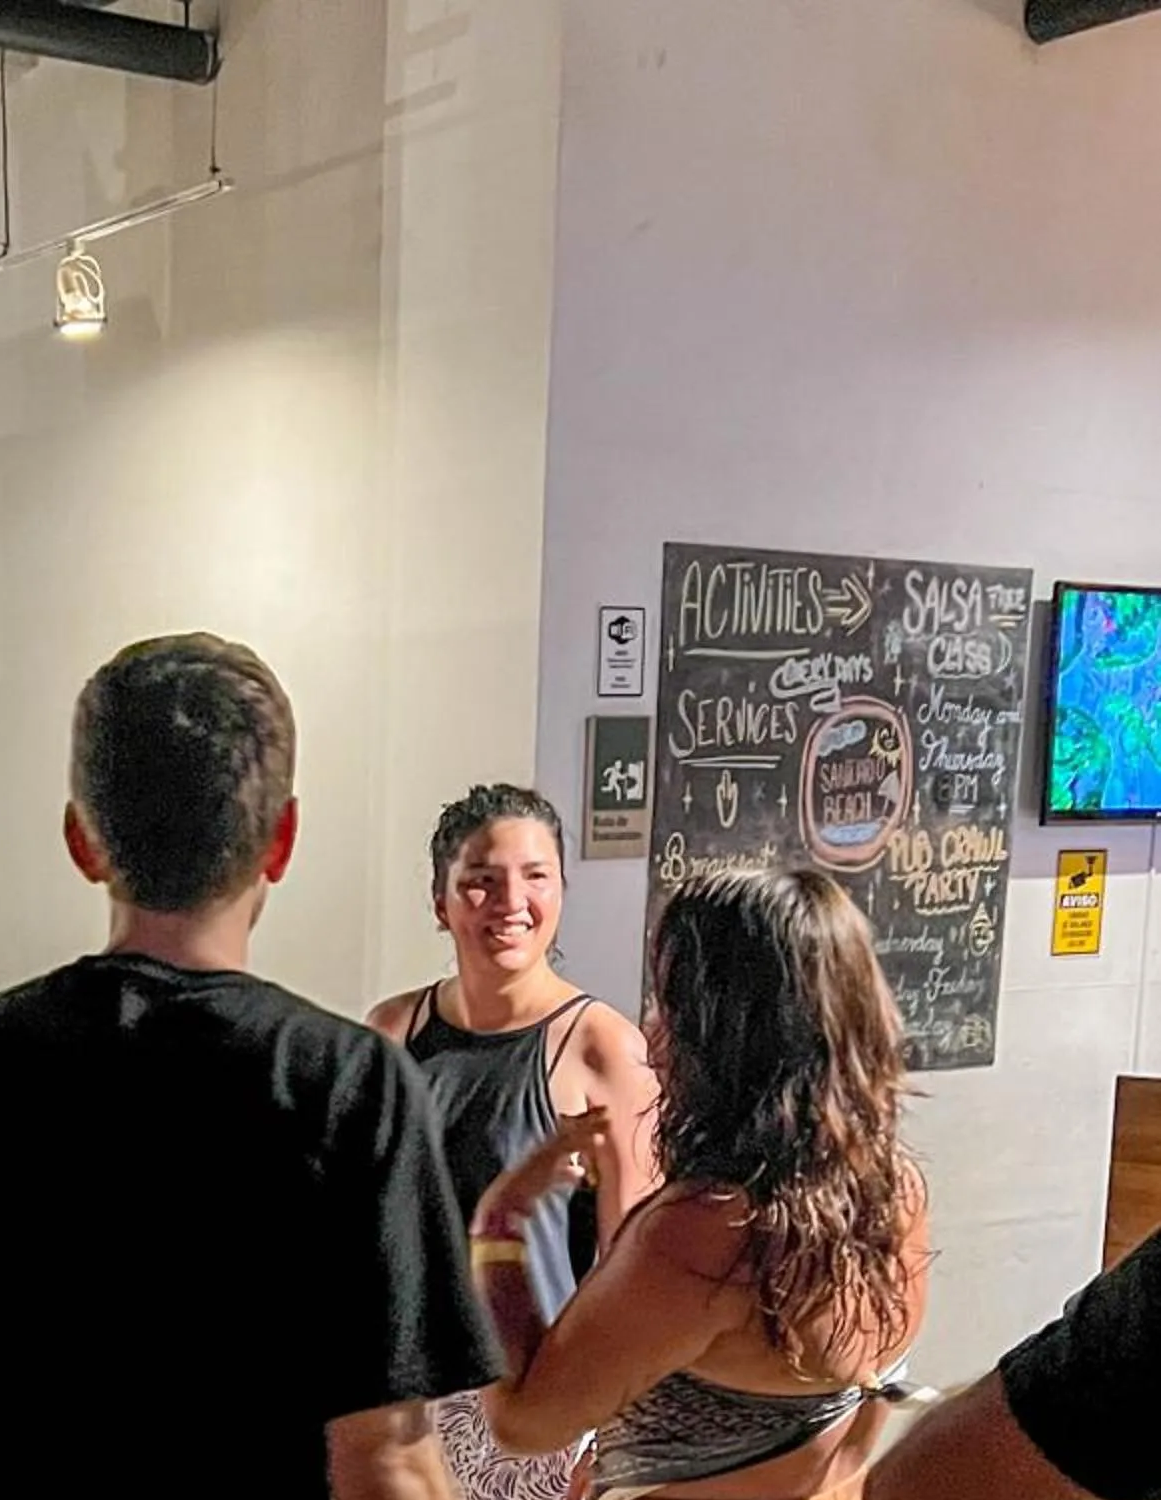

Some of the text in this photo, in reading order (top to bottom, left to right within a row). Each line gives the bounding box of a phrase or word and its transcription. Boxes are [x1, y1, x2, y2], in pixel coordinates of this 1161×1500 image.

[902, 569, 982, 639] SALSA
[669, 689, 800, 758] SERVICES
[917, 682, 993, 748] Monday
[888, 829, 934, 873] PUB
[904, 869, 979, 905] PARTY
